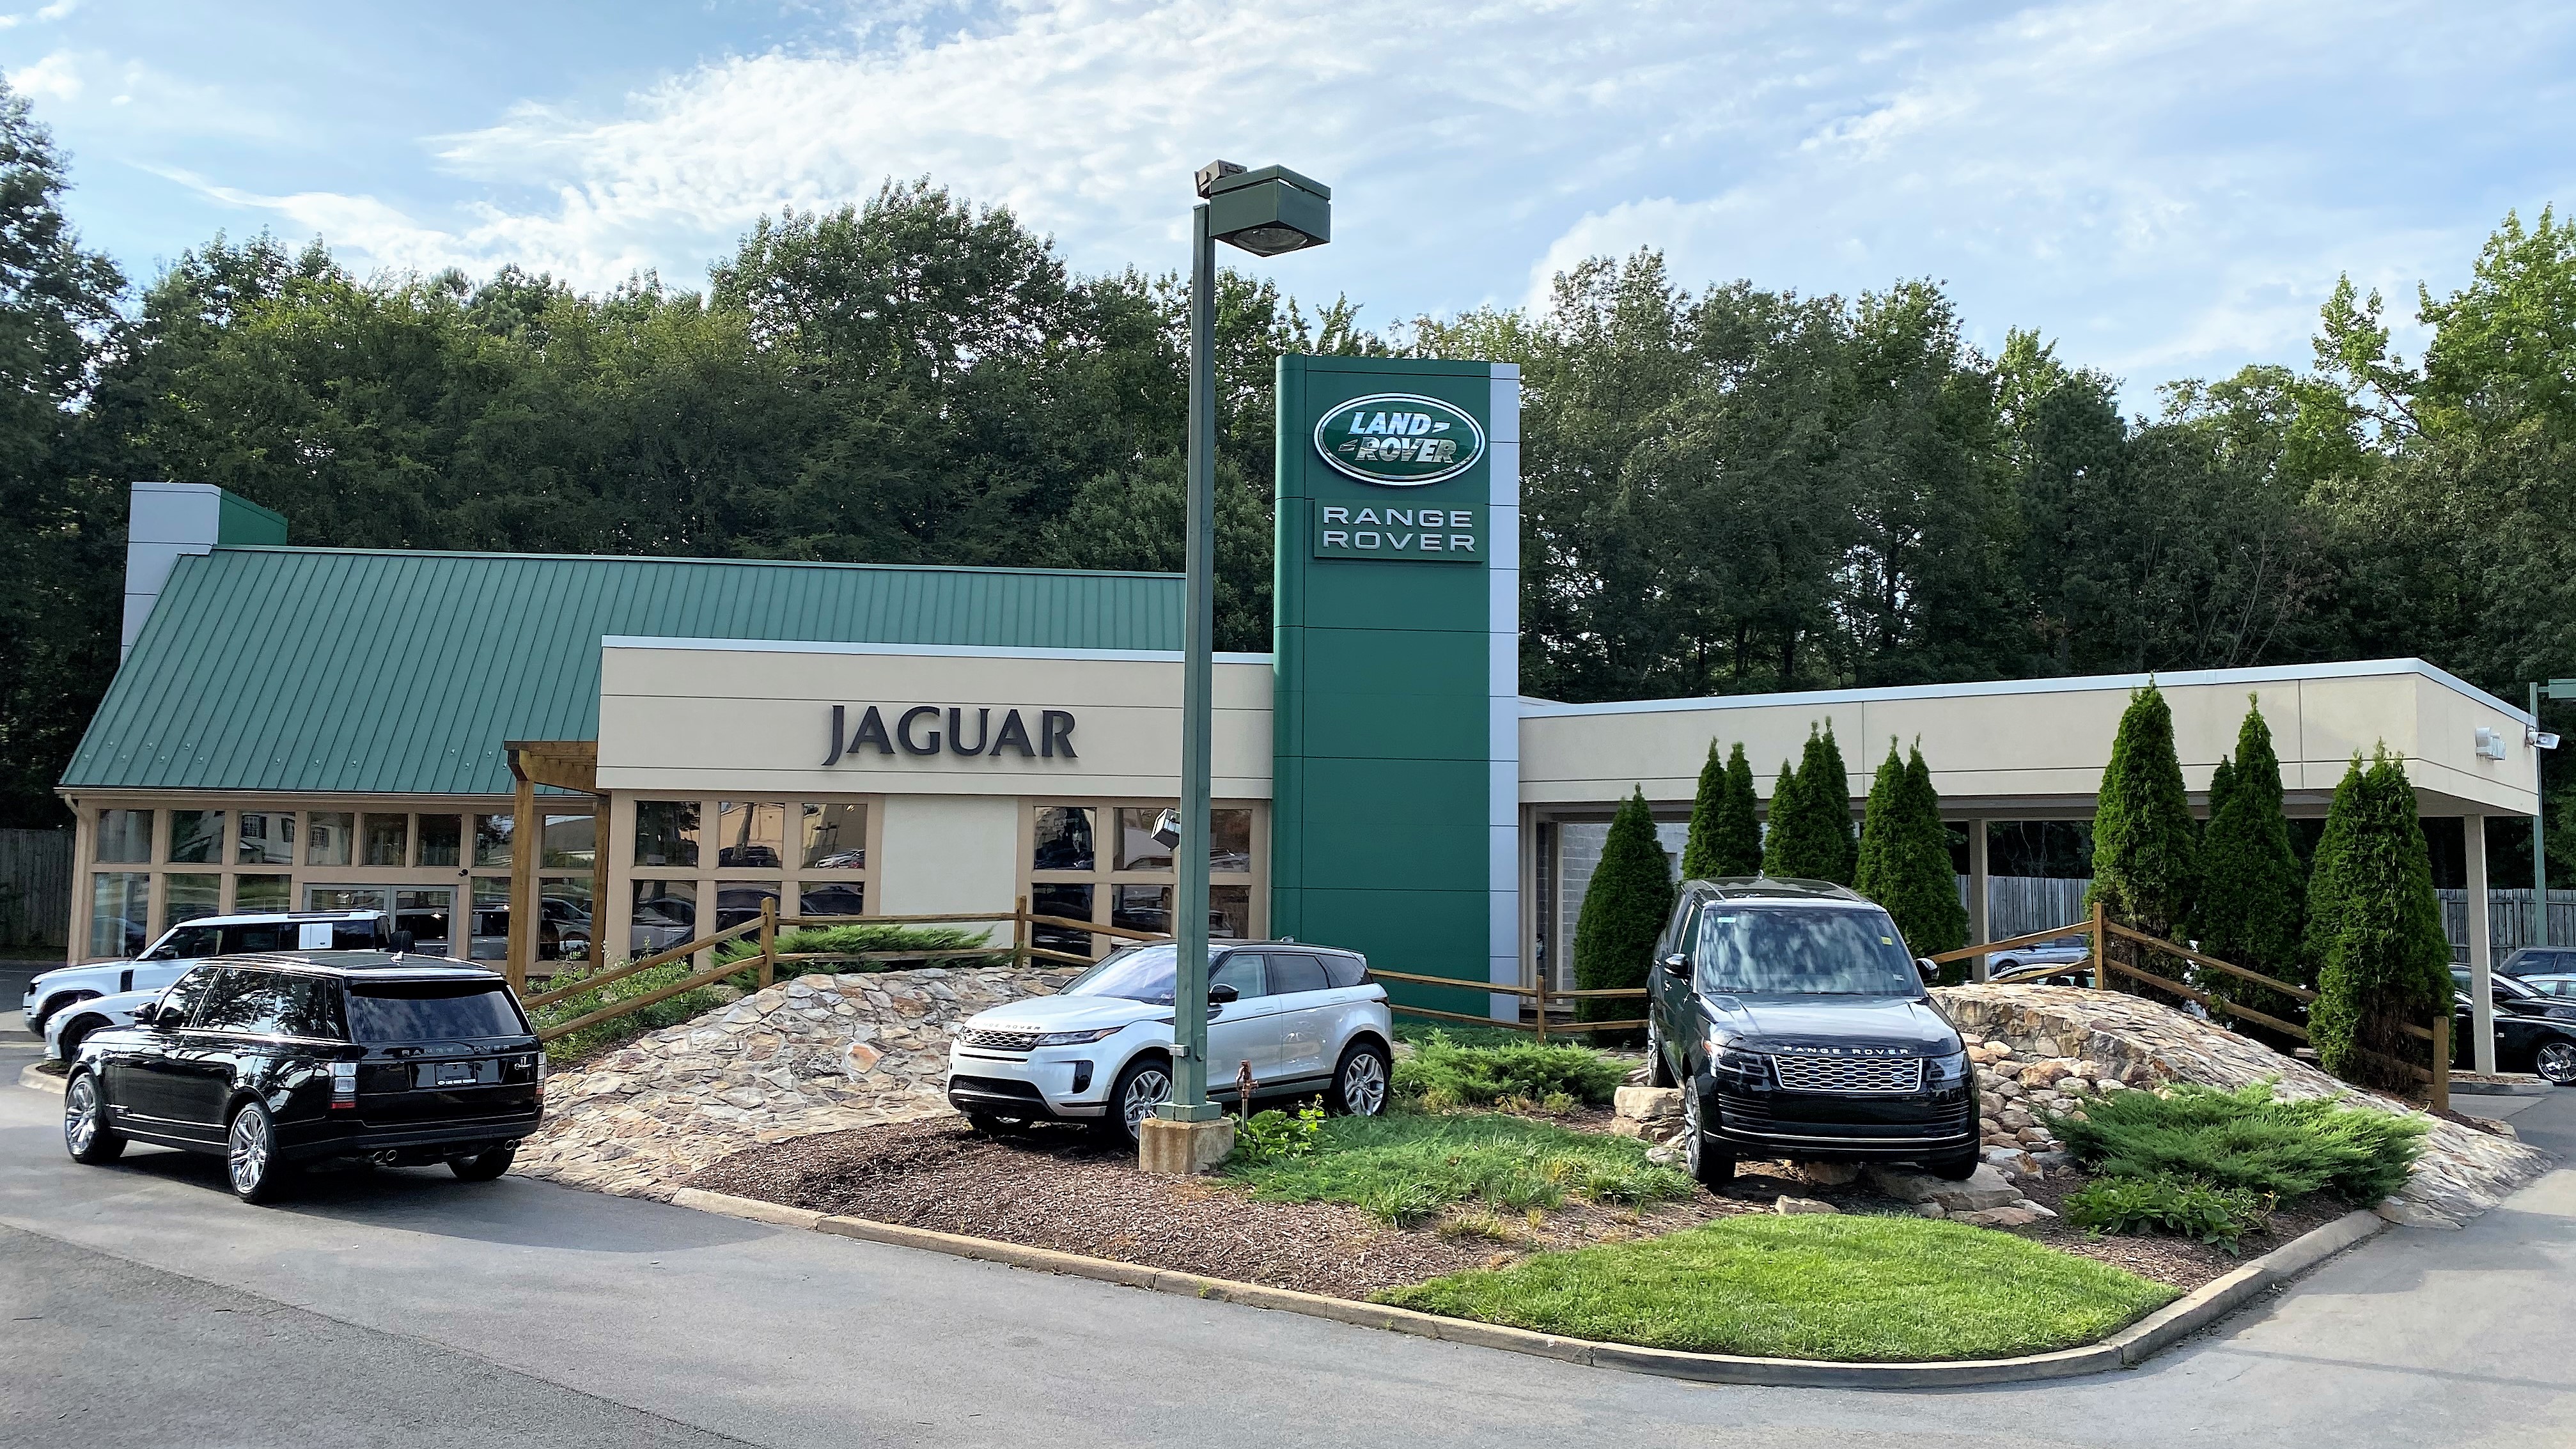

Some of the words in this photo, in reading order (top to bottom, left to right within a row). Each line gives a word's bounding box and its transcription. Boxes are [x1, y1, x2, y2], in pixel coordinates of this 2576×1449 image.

[1348, 411, 1432, 436] LAND
[1354, 437, 1457, 463] ROVER
[1323, 506, 1473, 528] RANGE
[1323, 530, 1476, 552] ROVER
[821, 705, 1079, 766] JAGUAR
[1783, 1046, 1841, 1055] RANGE
